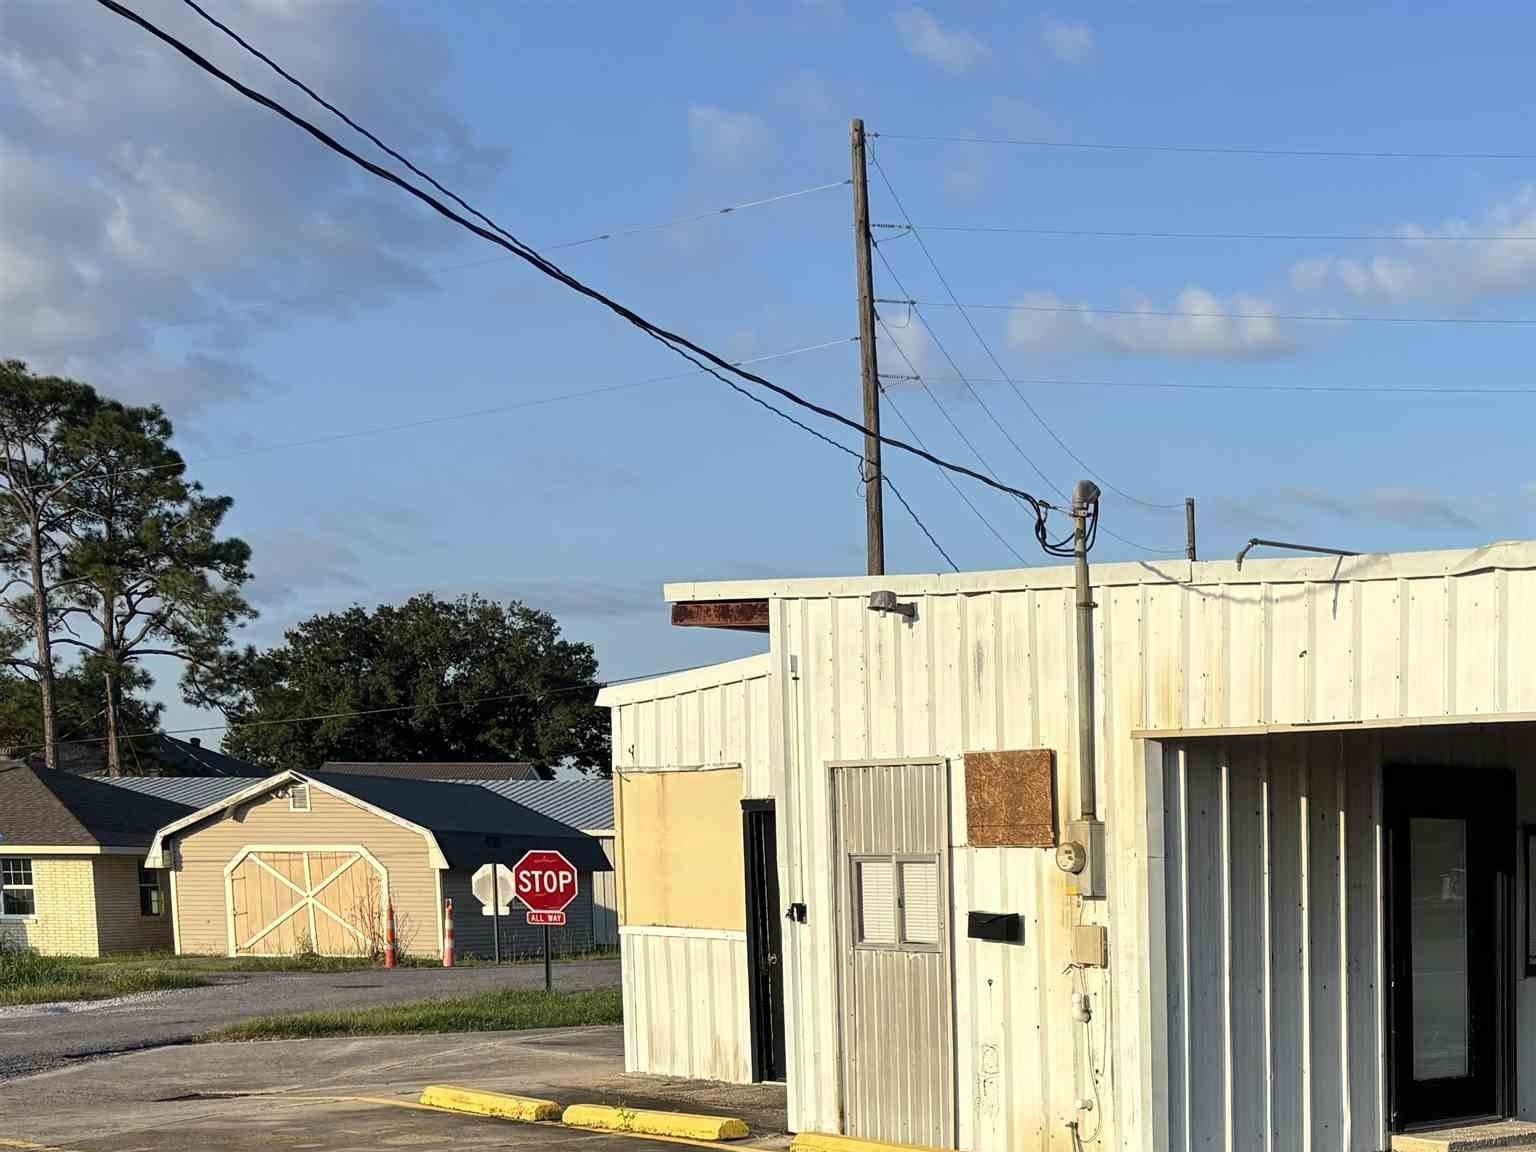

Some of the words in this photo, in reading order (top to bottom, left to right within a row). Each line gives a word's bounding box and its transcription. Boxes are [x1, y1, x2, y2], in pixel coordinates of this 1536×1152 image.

[519, 870, 572, 893] STOP
[530, 913, 544, 922] ALL
[547, 913, 562, 922] WAY
